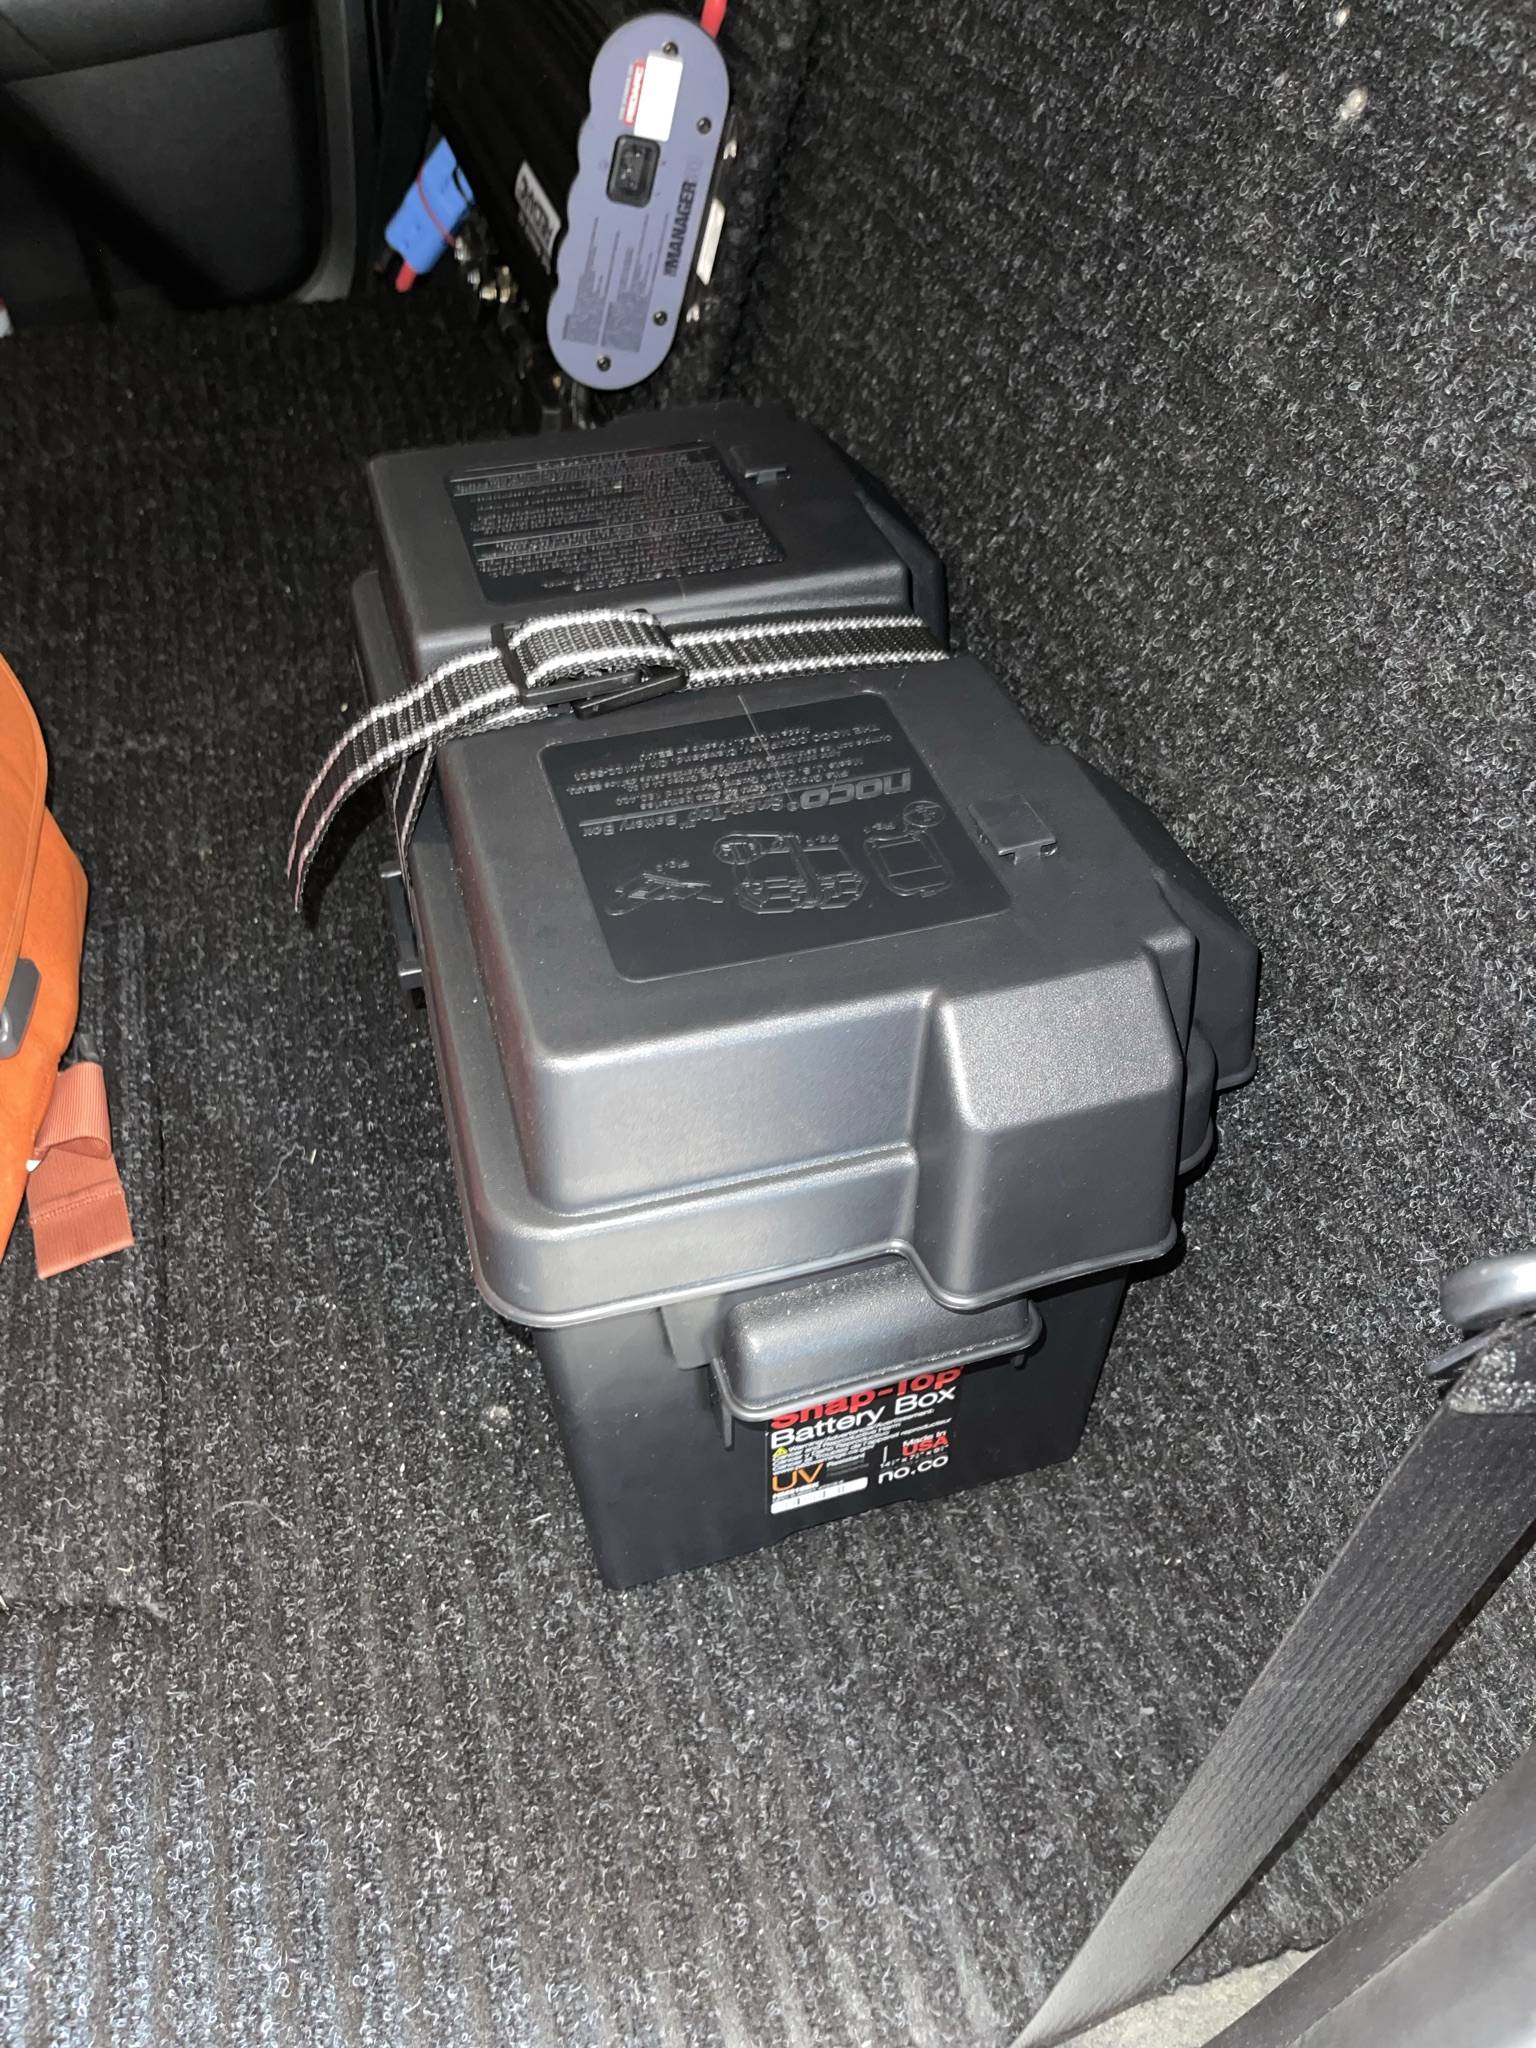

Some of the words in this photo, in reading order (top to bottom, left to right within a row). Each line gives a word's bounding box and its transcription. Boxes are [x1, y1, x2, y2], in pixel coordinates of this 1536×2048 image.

[771, 1406, 885, 1450] Battery
[894, 1386, 956, 1415] Box
[902, 1436, 949, 1457] USA
[772, 1462, 824, 1492] UV
[878, 1455, 948, 1485] no.co
